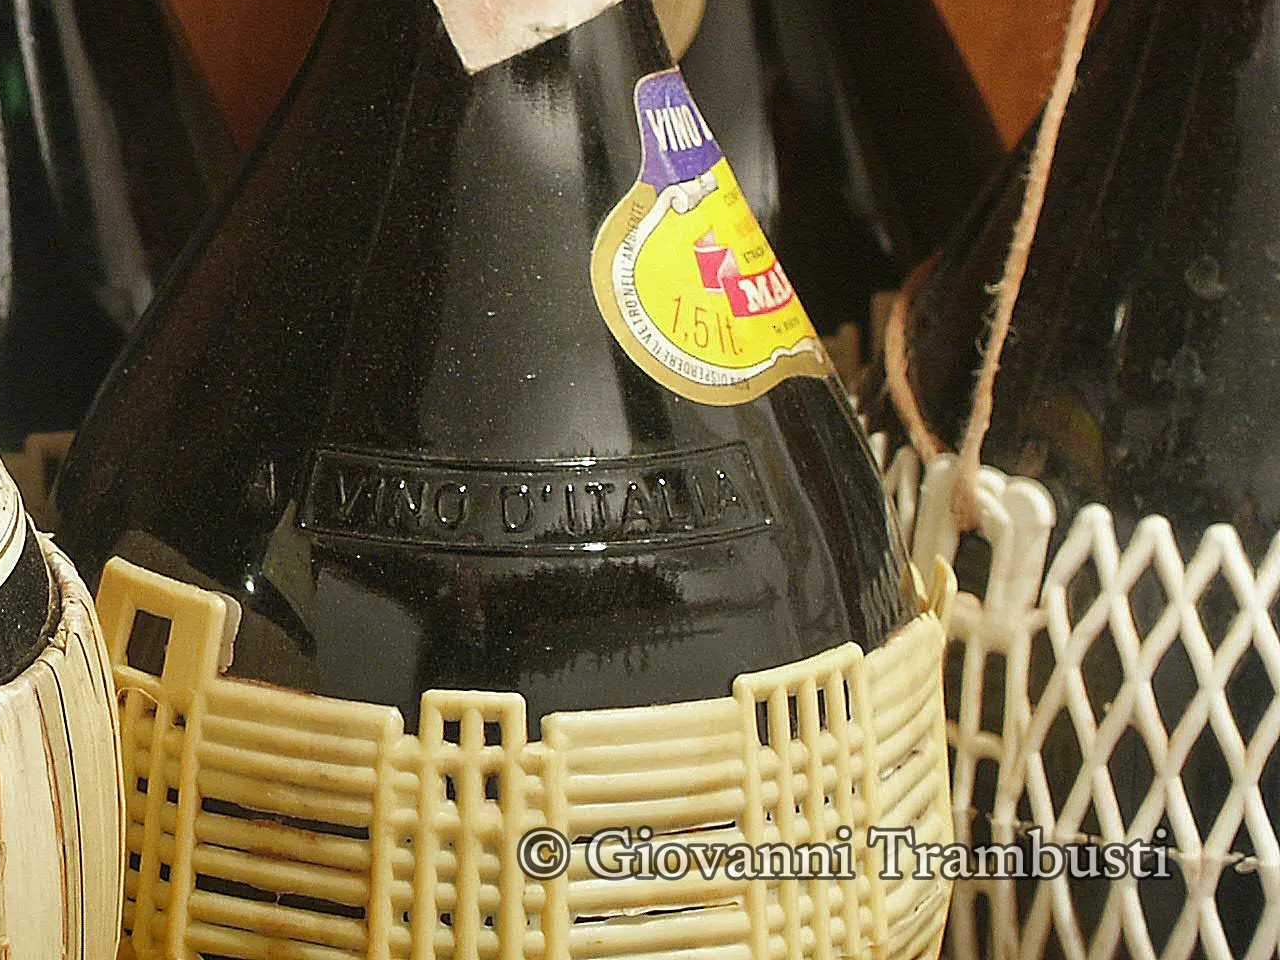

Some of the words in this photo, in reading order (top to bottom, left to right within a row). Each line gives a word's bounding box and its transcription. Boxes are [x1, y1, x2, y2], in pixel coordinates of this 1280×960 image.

[645, 103, 703, 152] VINO
[337, 472, 472, 533] VINO
[497, 464, 747, 538] D'ITALIA
